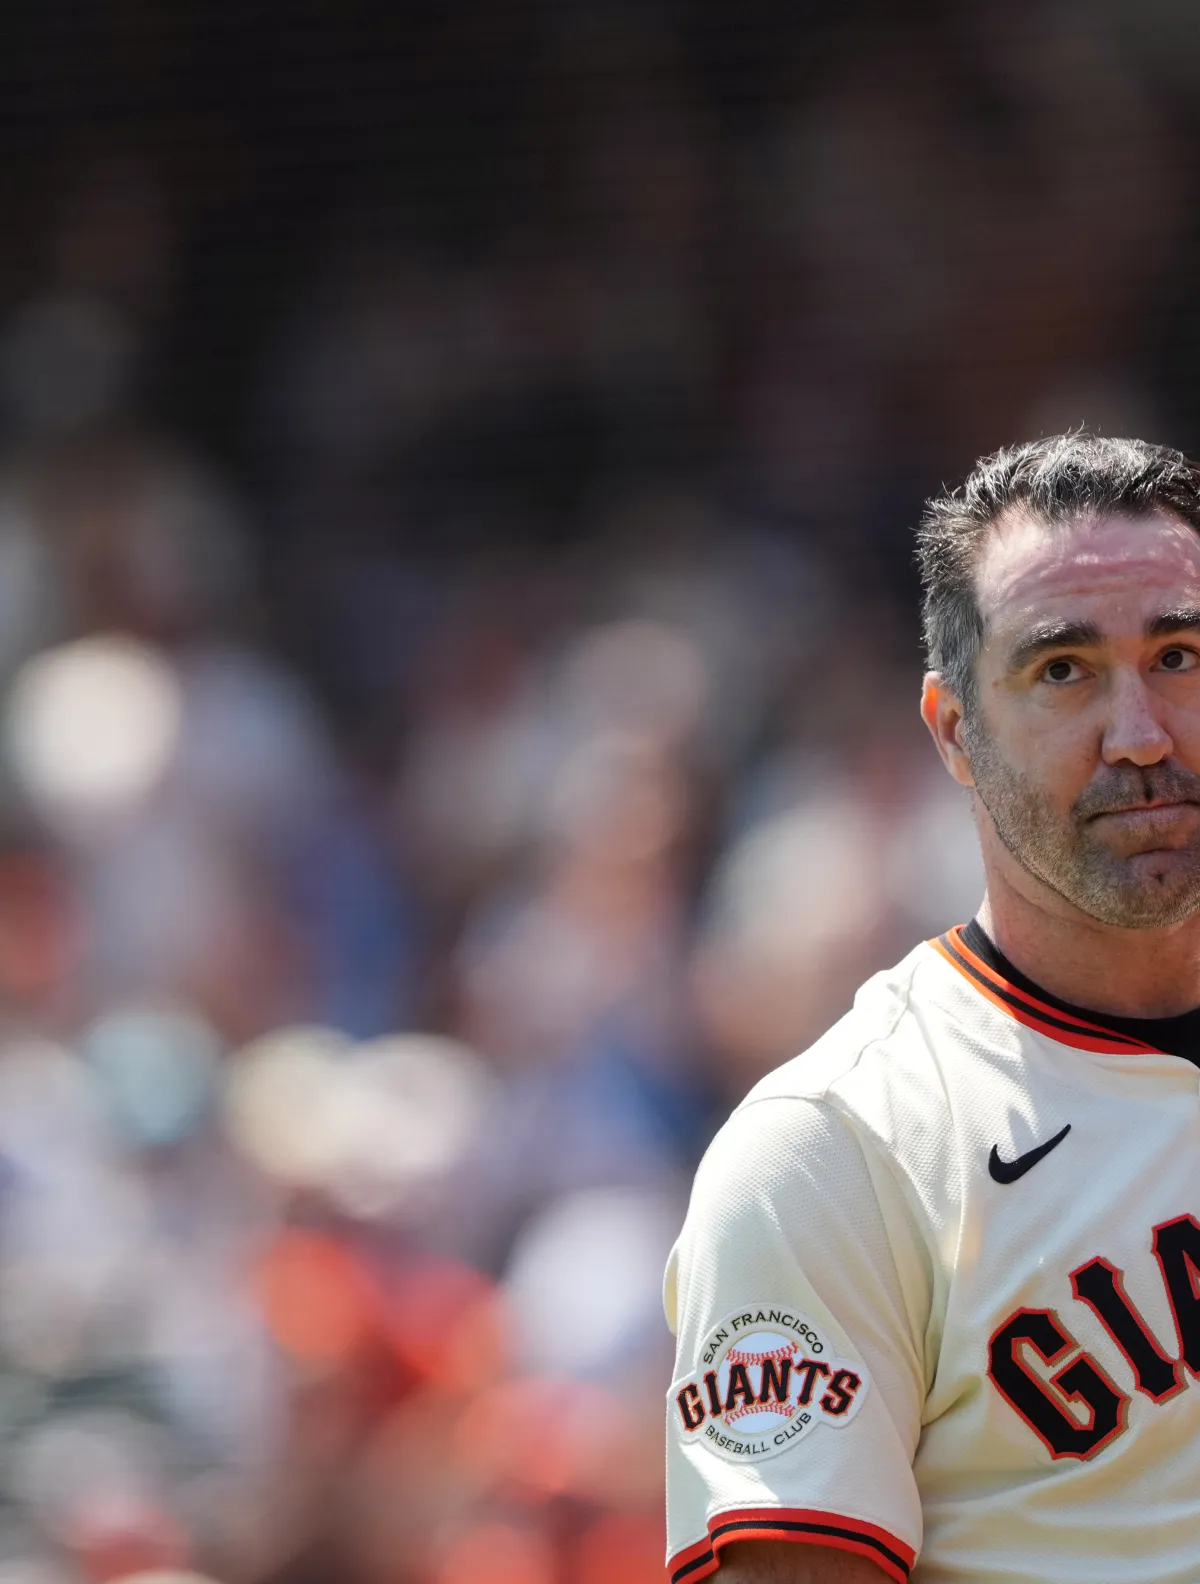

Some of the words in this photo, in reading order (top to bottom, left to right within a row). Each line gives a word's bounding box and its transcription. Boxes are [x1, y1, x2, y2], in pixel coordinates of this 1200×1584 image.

[703, 1328, 729, 1364] SAN
[731, 1310, 824, 1354] FRANCISCO
[676, 1358, 863, 1432] GIANTS
[705, 1425, 770, 1455] BASEBALL
[774, 1412, 812, 1445] CLUB
